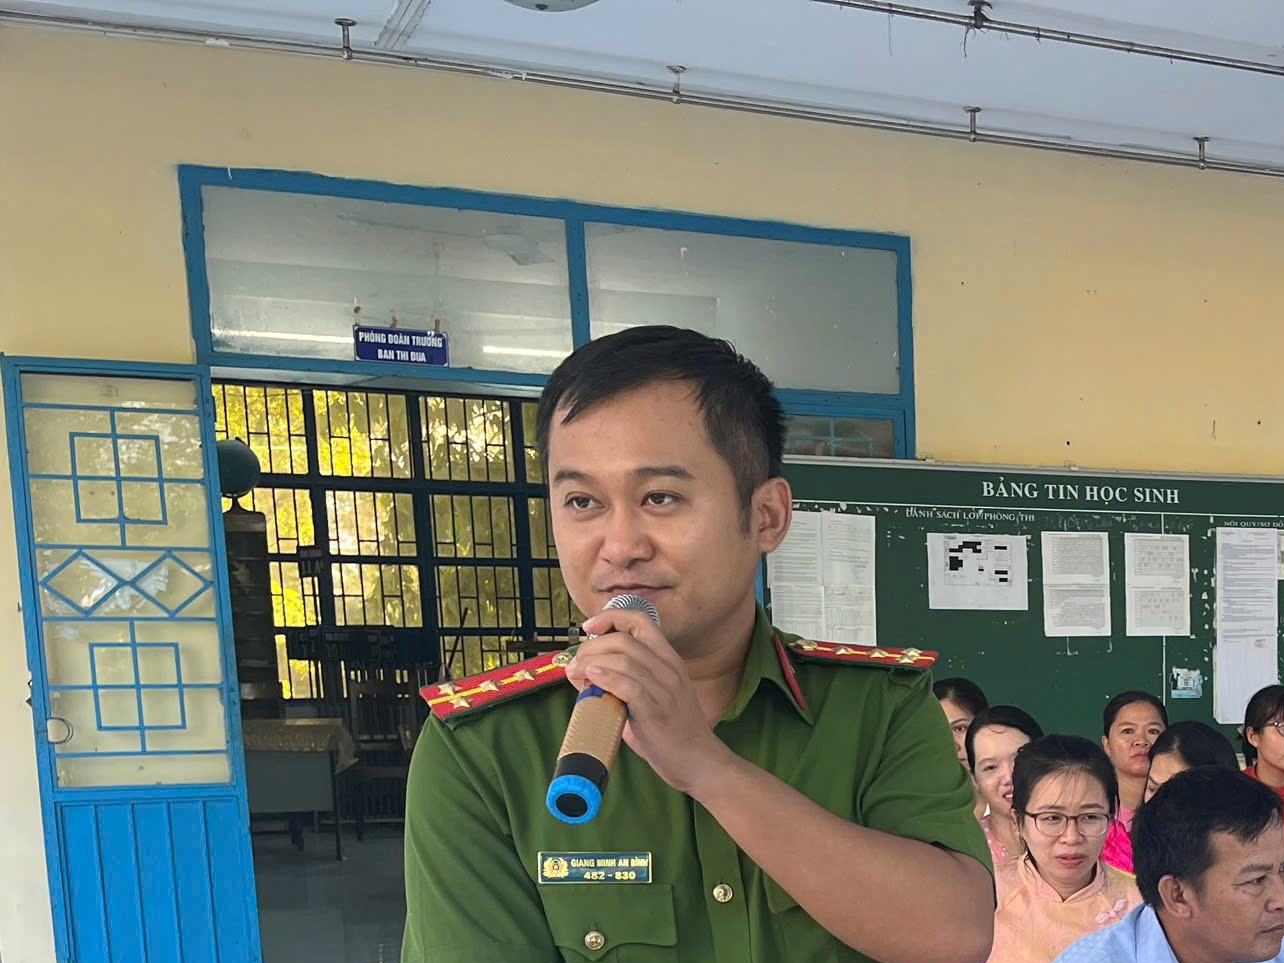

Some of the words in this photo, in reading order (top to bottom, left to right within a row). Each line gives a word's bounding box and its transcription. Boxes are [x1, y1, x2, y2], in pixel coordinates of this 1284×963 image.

[359, 330, 387, 344] PHÒNG
[377, 349, 394, 360] BAN
[396, 350, 409, 361] THI
[982, 476, 1039, 499] BẢNG
[1044, 484, 1079, 500] TIN
[1085, 485, 1128, 505] HỌC
[1133, 487, 1180, 504] SINH
[570, 858, 595, 867] GIANG
[617, 858, 629, 867] AN
[583, 871, 606, 880] 482
[614, 871, 636, 880] 830
